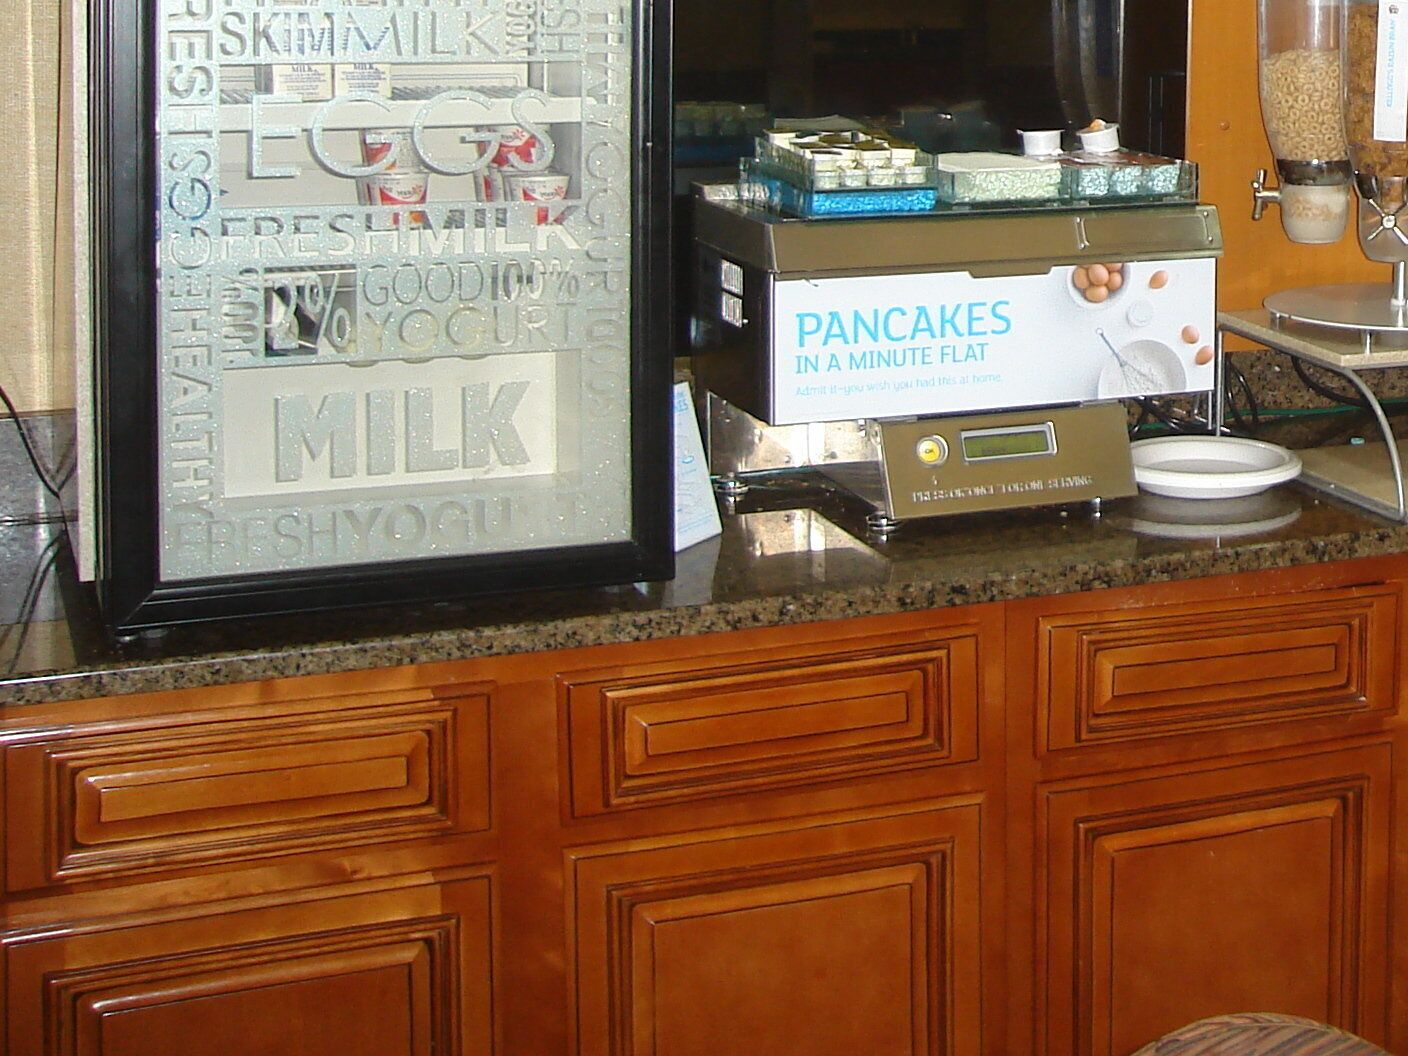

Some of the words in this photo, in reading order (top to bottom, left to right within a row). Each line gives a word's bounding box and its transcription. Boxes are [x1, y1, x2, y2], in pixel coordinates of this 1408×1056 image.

[249, 89, 555, 178] EGGS
[169, 148, 213, 298] EGGS
[268, 269, 352, 354] 2%
[364, 302, 575, 353] YOGURT
[795, 300, 1012, 348] PANCAKES
[795, 354, 820, 375] IN
[827, 352, 843, 372] A
[848, 347, 934, 371] MINUTE
[940, 342, 989, 364] FLAT
[795, 384, 828, 397] Admit
[866, 378, 891, 392] wish
[893, 378, 914, 394] you
[916, 375, 936, 389] had
[938, 374, 957, 387] this
[959, 375, 971, 386] at
[168, 308, 215, 520] HEALTHY
[273, 379, 532, 484] MILK
[341, 492, 585, 549] YOGUT
